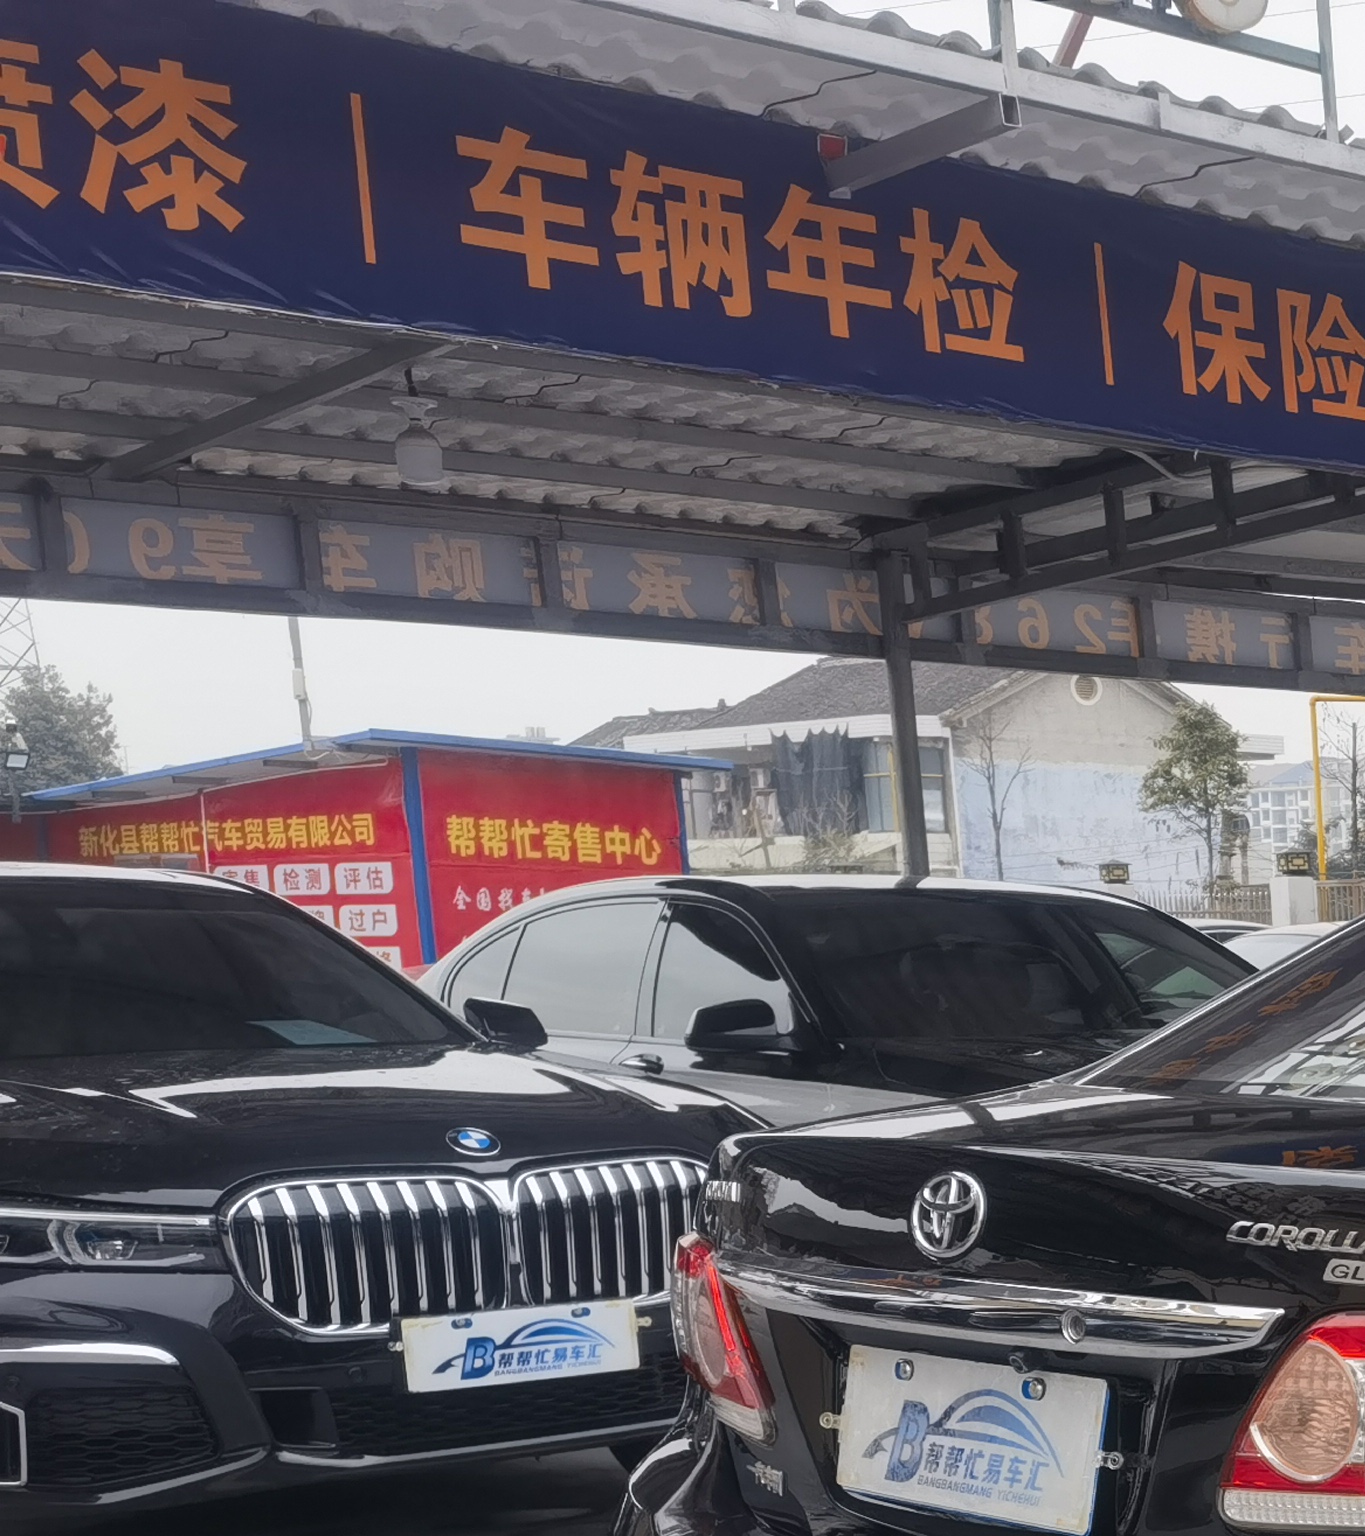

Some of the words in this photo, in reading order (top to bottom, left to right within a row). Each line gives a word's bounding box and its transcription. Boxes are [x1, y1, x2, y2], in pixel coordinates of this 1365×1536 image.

[455, 126, 1026, 363] 车辆年检
[78, 812, 376, 858] 新化县帮帮忙汽车贸易有限公司
[446, 814, 662, 866] 帮帮忙寄售中心
[283, 868, 322, 891] 检测
[344, 866, 384, 891] 评估
[348, 909, 388, 932] 过户
[498, 1343, 604, 1369] 帮帮忙易车汇
[923, 1441, 1049, 1492] 帮帮忙易车汇
[917, 1474, 992, 1499] BANGBANGMANG
